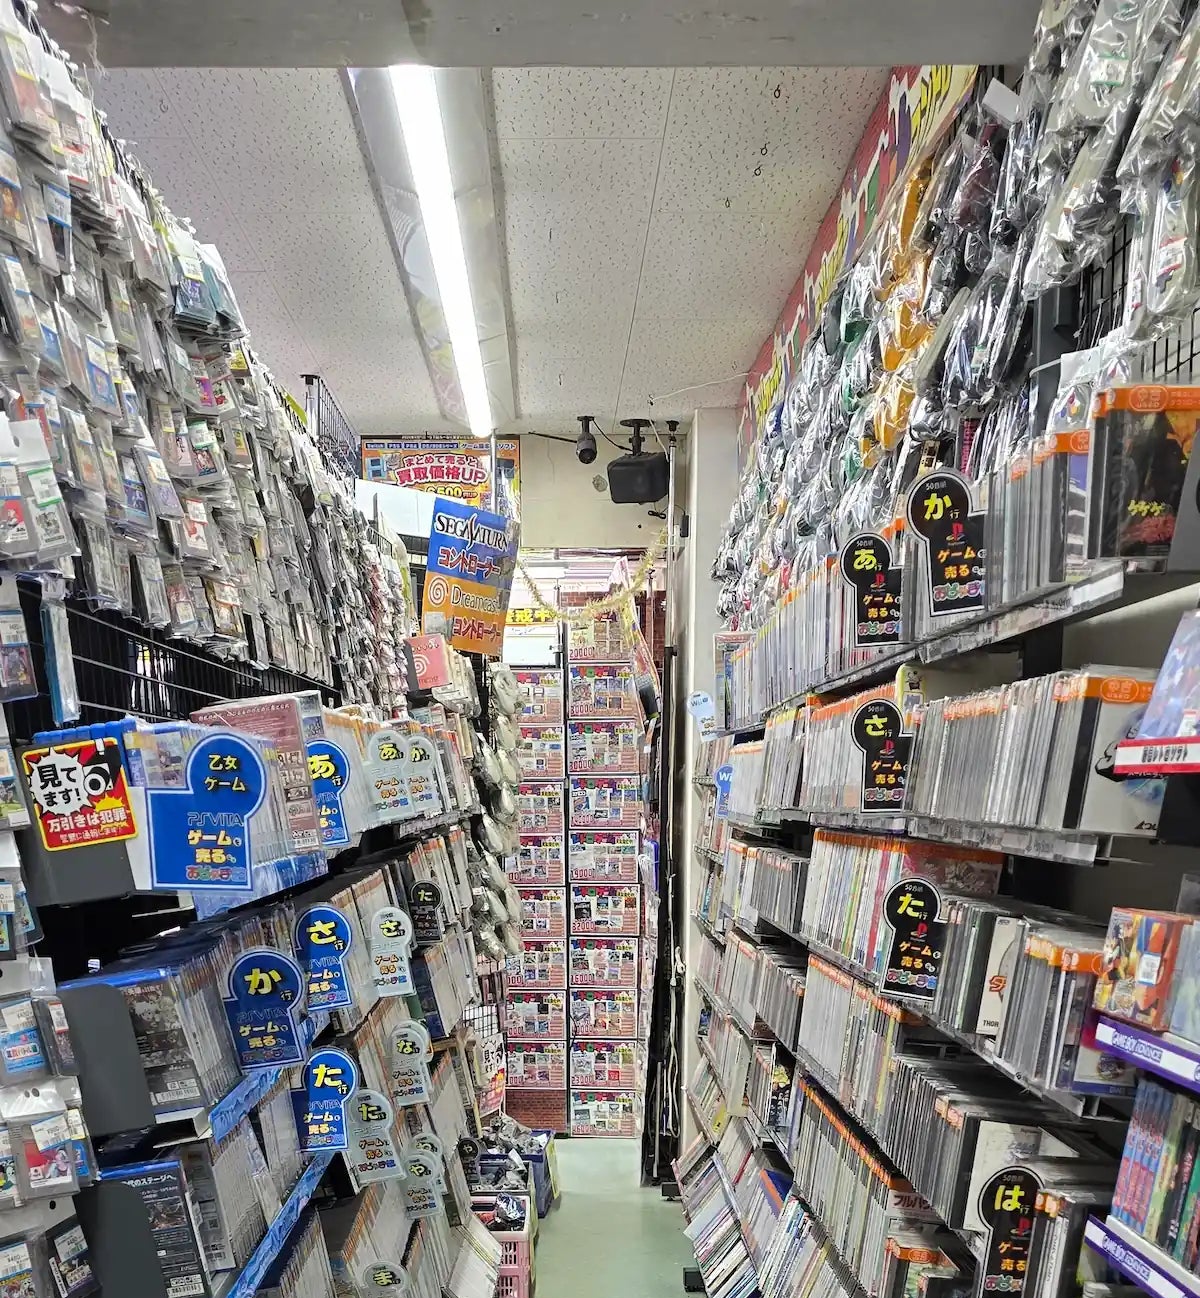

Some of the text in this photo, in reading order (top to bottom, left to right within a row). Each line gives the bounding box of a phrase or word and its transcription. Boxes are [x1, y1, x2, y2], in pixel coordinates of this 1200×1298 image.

[404, 454, 478, 468] まとめて売ると
[395, 465, 487, 485] 買取価格UP
[1107, 679, 1132, 693] 中古
[208, 754, 240, 772] 乙女
[36, 763, 78, 790] 見て
[203, 776, 247, 793] ゲーム
[43, 787, 81, 807] ます!
[46, 806, 128, 833] 万引きは犯罪
